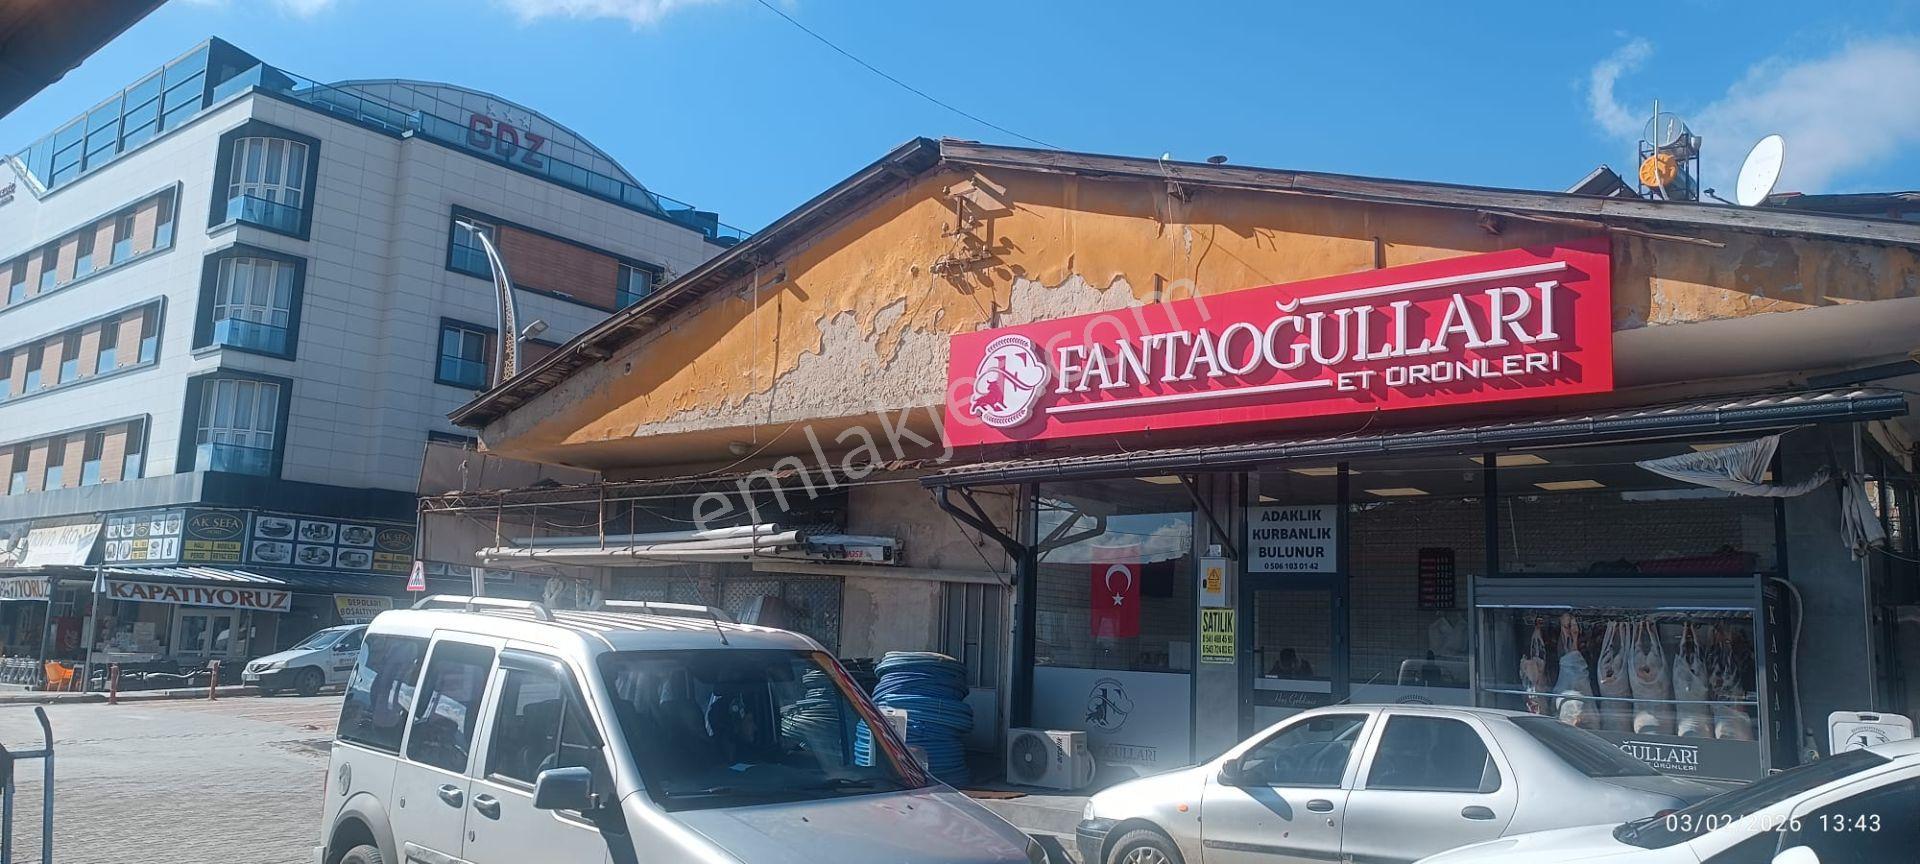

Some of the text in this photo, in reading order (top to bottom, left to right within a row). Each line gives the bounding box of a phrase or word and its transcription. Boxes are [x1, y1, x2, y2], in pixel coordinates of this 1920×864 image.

[466, 113, 545, 169] GDZ
[1054, 280, 1560, 394] FANTAOĞULLARI
[1337, 369, 1376, 391] ET
[192, 518, 239, 528] AK SEFA
[1261, 509, 1322, 522] ADAKLIK
[1252, 527, 1332, 540] KURBANLIK
[1259, 546, 1325, 558] BULUNUR
[109, 582, 289, 610] KAPATIYORUZ
[1202, 612, 1233, 633] SATILIK
[1769, 605, 1781, 741] KASAP
